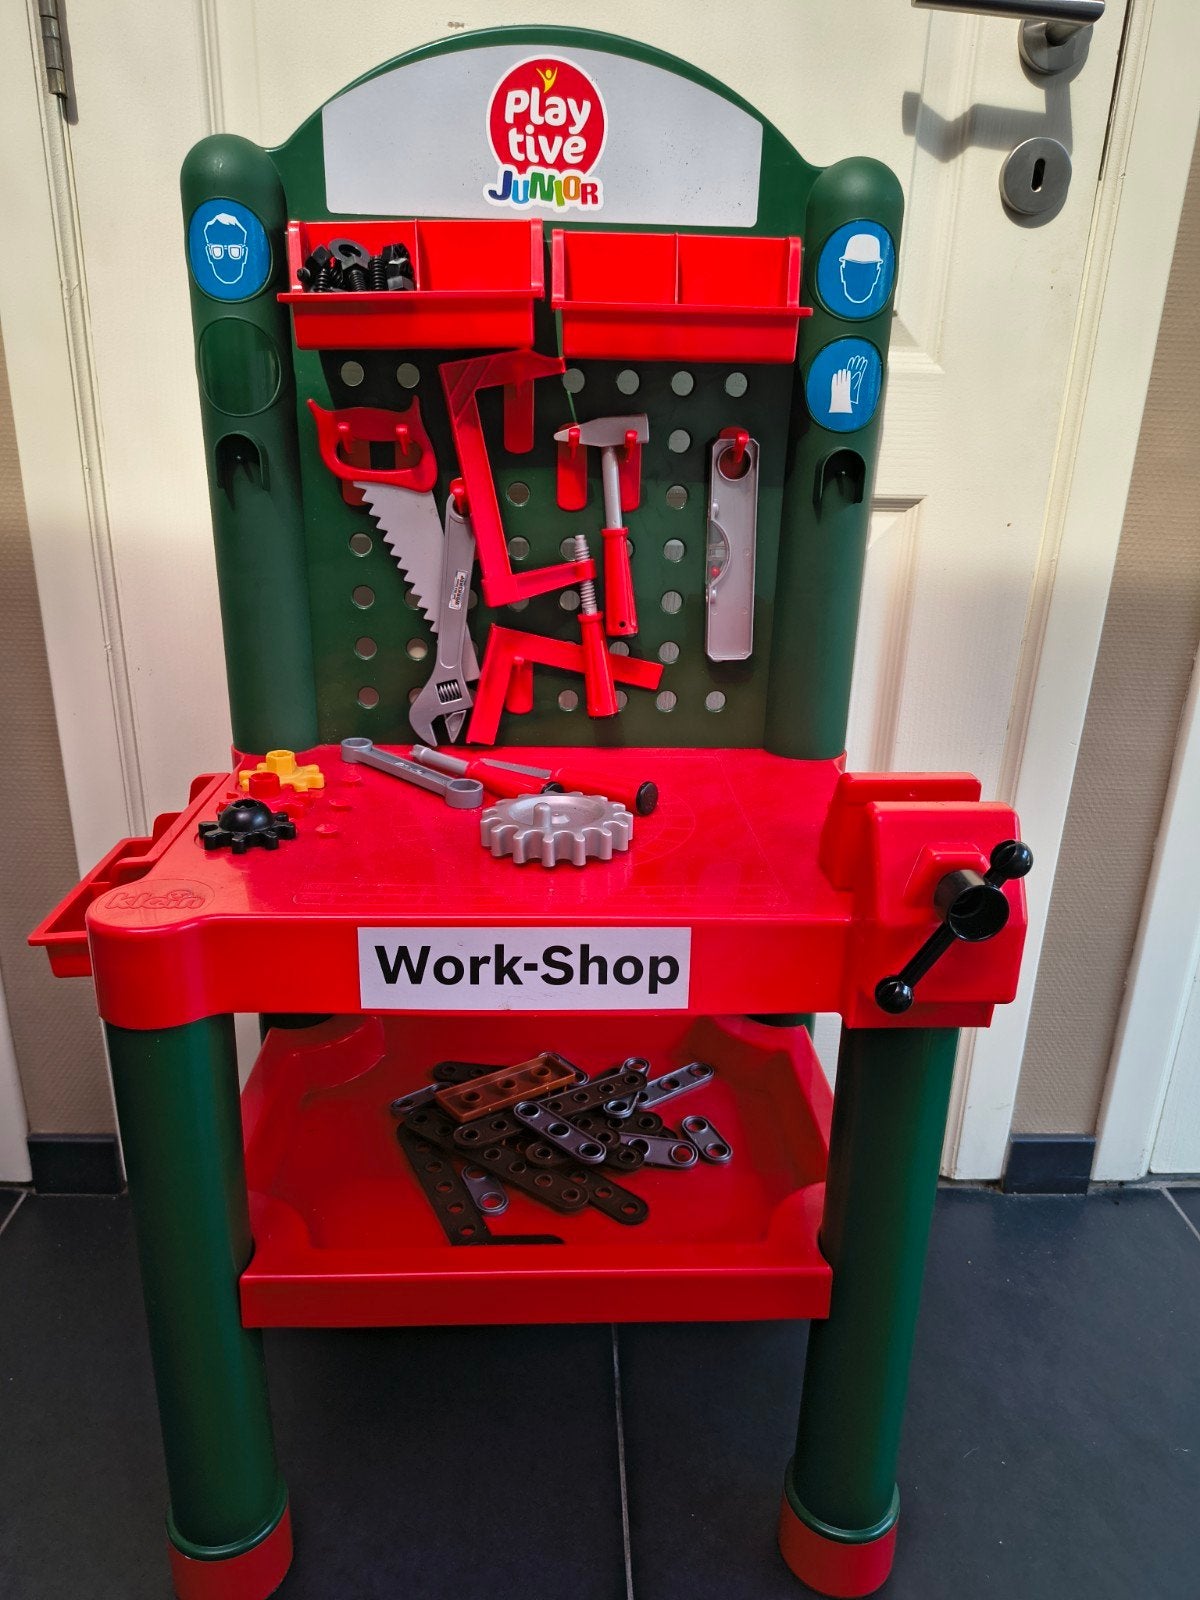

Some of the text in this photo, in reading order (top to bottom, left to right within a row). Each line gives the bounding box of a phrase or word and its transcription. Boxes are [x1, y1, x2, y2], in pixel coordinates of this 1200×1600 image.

[505, 87, 592, 135] Play
[508, 125, 587, 165] tive
[488, 170, 599, 207] JUNIOR
[105, 890, 205, 910] klein
[374, 944, 680, 995] Work-Shop
